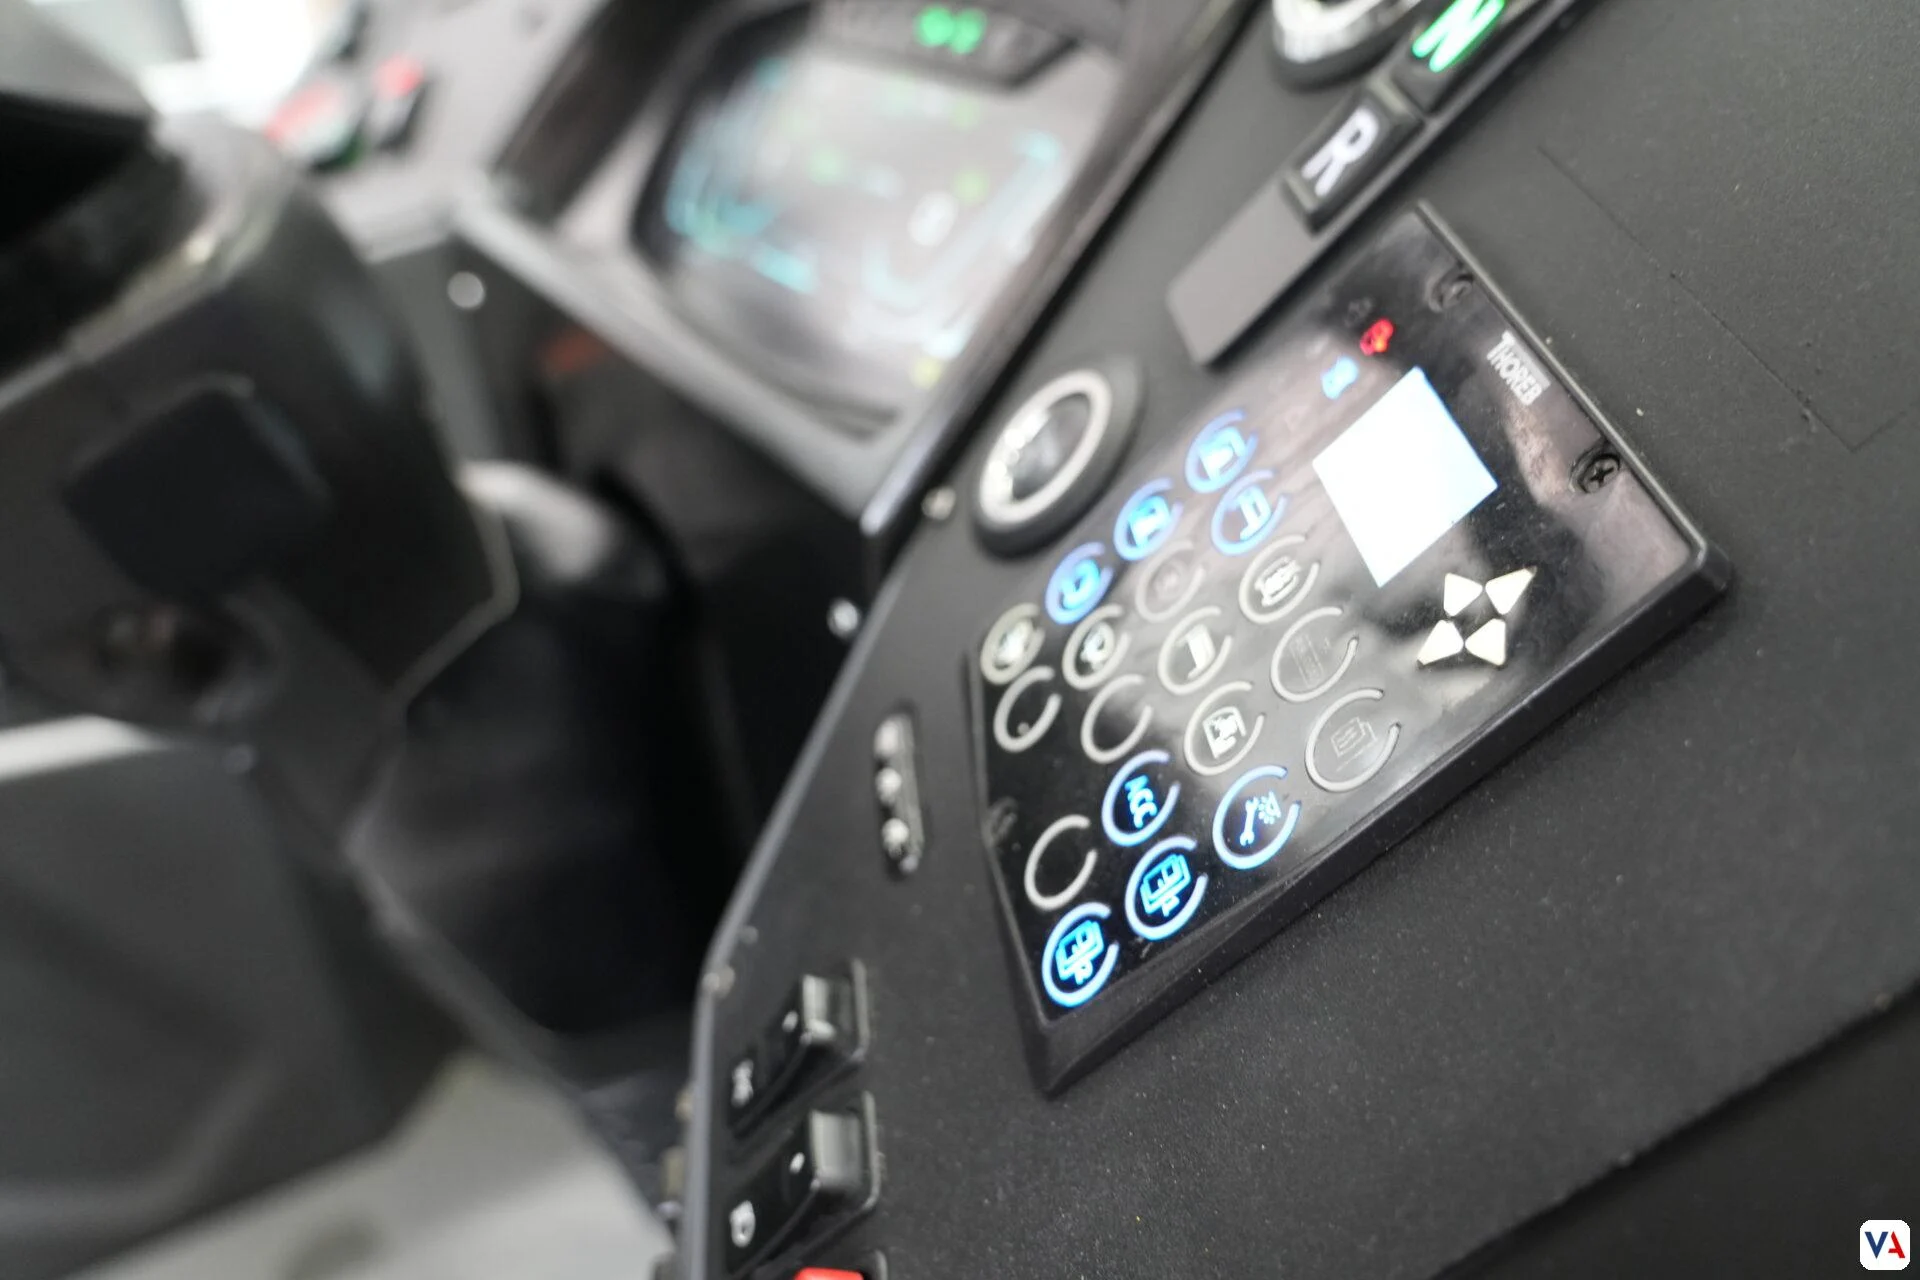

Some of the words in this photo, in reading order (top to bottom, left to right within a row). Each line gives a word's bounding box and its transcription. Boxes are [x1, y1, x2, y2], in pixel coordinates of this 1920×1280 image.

[1412, 0, 1506, 72] N
[1301, 105, 1380, 198] R
[1124, 774, 1158, 829] ACC
